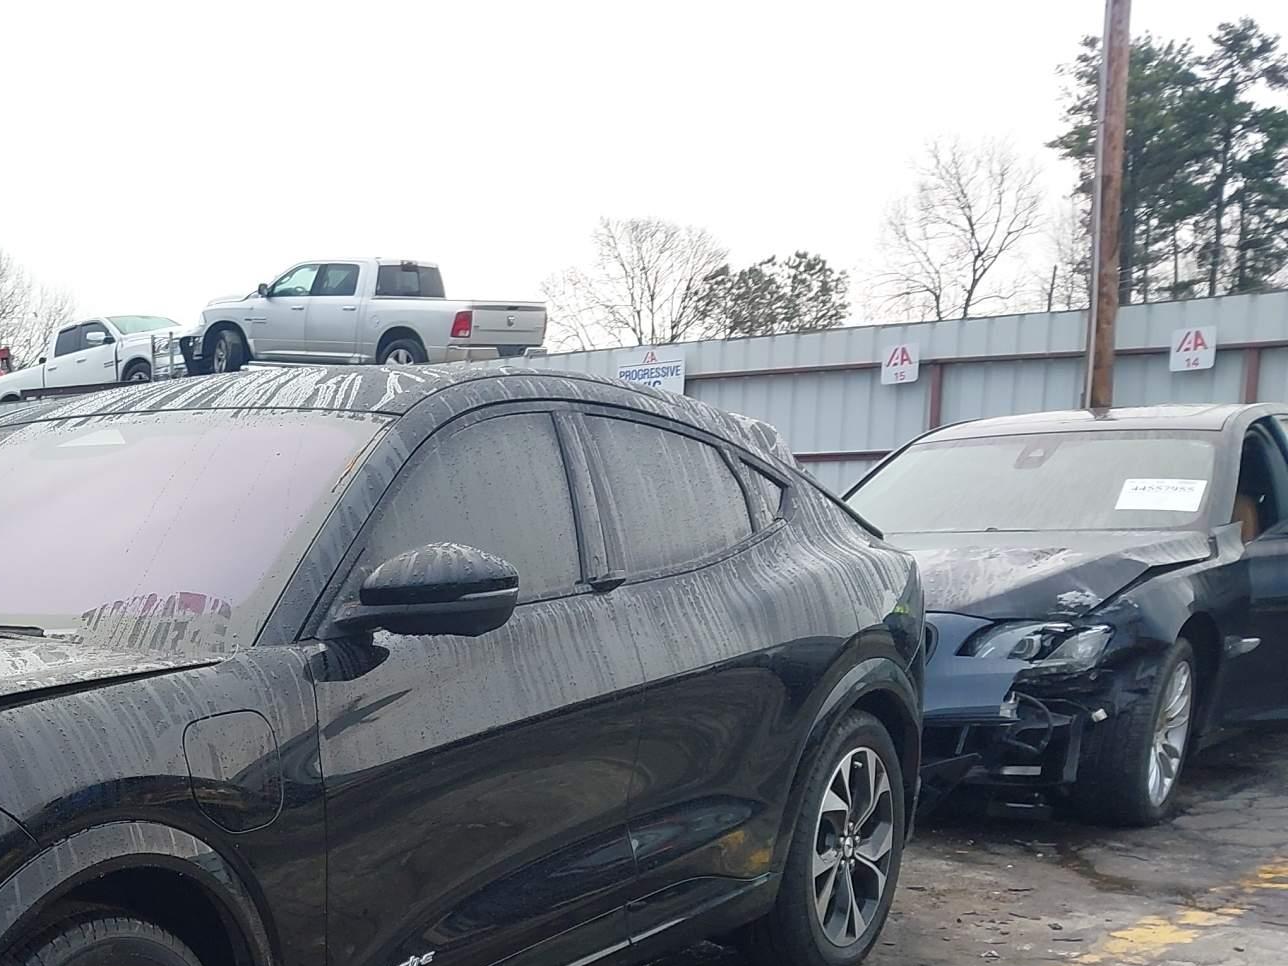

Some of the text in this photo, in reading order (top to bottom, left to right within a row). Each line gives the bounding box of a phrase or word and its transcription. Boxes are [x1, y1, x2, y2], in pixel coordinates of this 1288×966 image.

[1185, 357, 1200, 368] 14
[619, 366, 681, 381] PROGRESSIVE
[893, 371, 905, 381] 15
